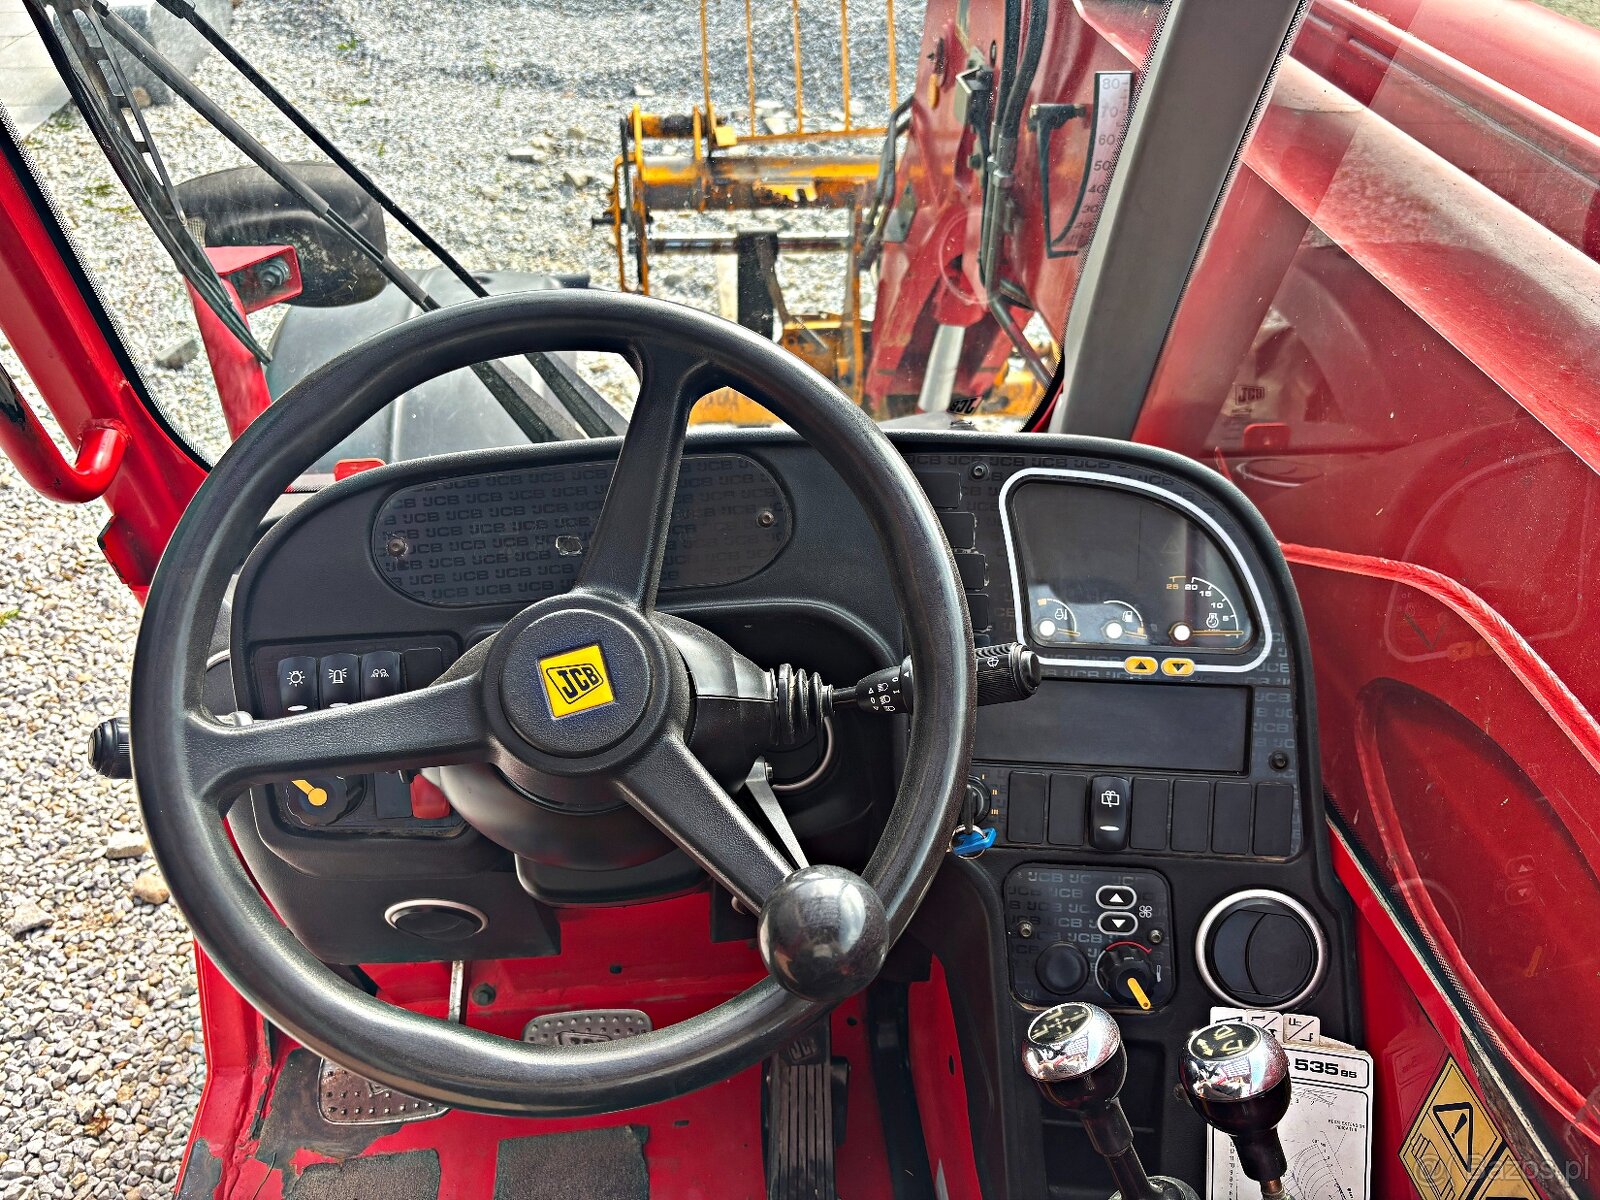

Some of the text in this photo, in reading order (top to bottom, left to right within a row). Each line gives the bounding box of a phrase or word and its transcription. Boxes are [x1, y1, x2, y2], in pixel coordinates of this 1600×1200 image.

[1103, 78, 1120, 90] 80
[1101, 106, 1118, 118] 70
[1098, 134, 1115, 146] 60
[1093, 160, 1110, 171] 50
[1088, 185, 1105, 194] 40
[989, 457, 1025, 468] JCB
[423, 495, 460, 507] JCB
[466, 492, 503, 504] JCB
[403, 512, 440, 524] JCB
[446, 508, 483, 521] JCB
[489, 506, 526, 518] JCB
[531, 503, 569, 515] JCB
[426, 526, 463, 538] JCB
[492, 537, 529, 549] JCB
[429, 557, 466, 569] JCB
[472, 554, 509, 566] JCB
[409, 574, 446, 586] JCB
[452, 571, 489, 582] JCB
[495, 567, 532, 579] JCB
[538, 564, 575, 576] JCB
[431, 587, 468, 599] JCB
[475, 584, 511, 596] JCB
[518, 581, 554, 592] JCB
[1184, 583, 1198, 591] 20
[556, 668, 600, 699] JCB
[1255, 692, 1290, 703] JCB
[1253, 722, 1289, 734] JCB
[1027, 871, 1064, 884] JCB
[1294, 1058, 1339, 1076] 535
